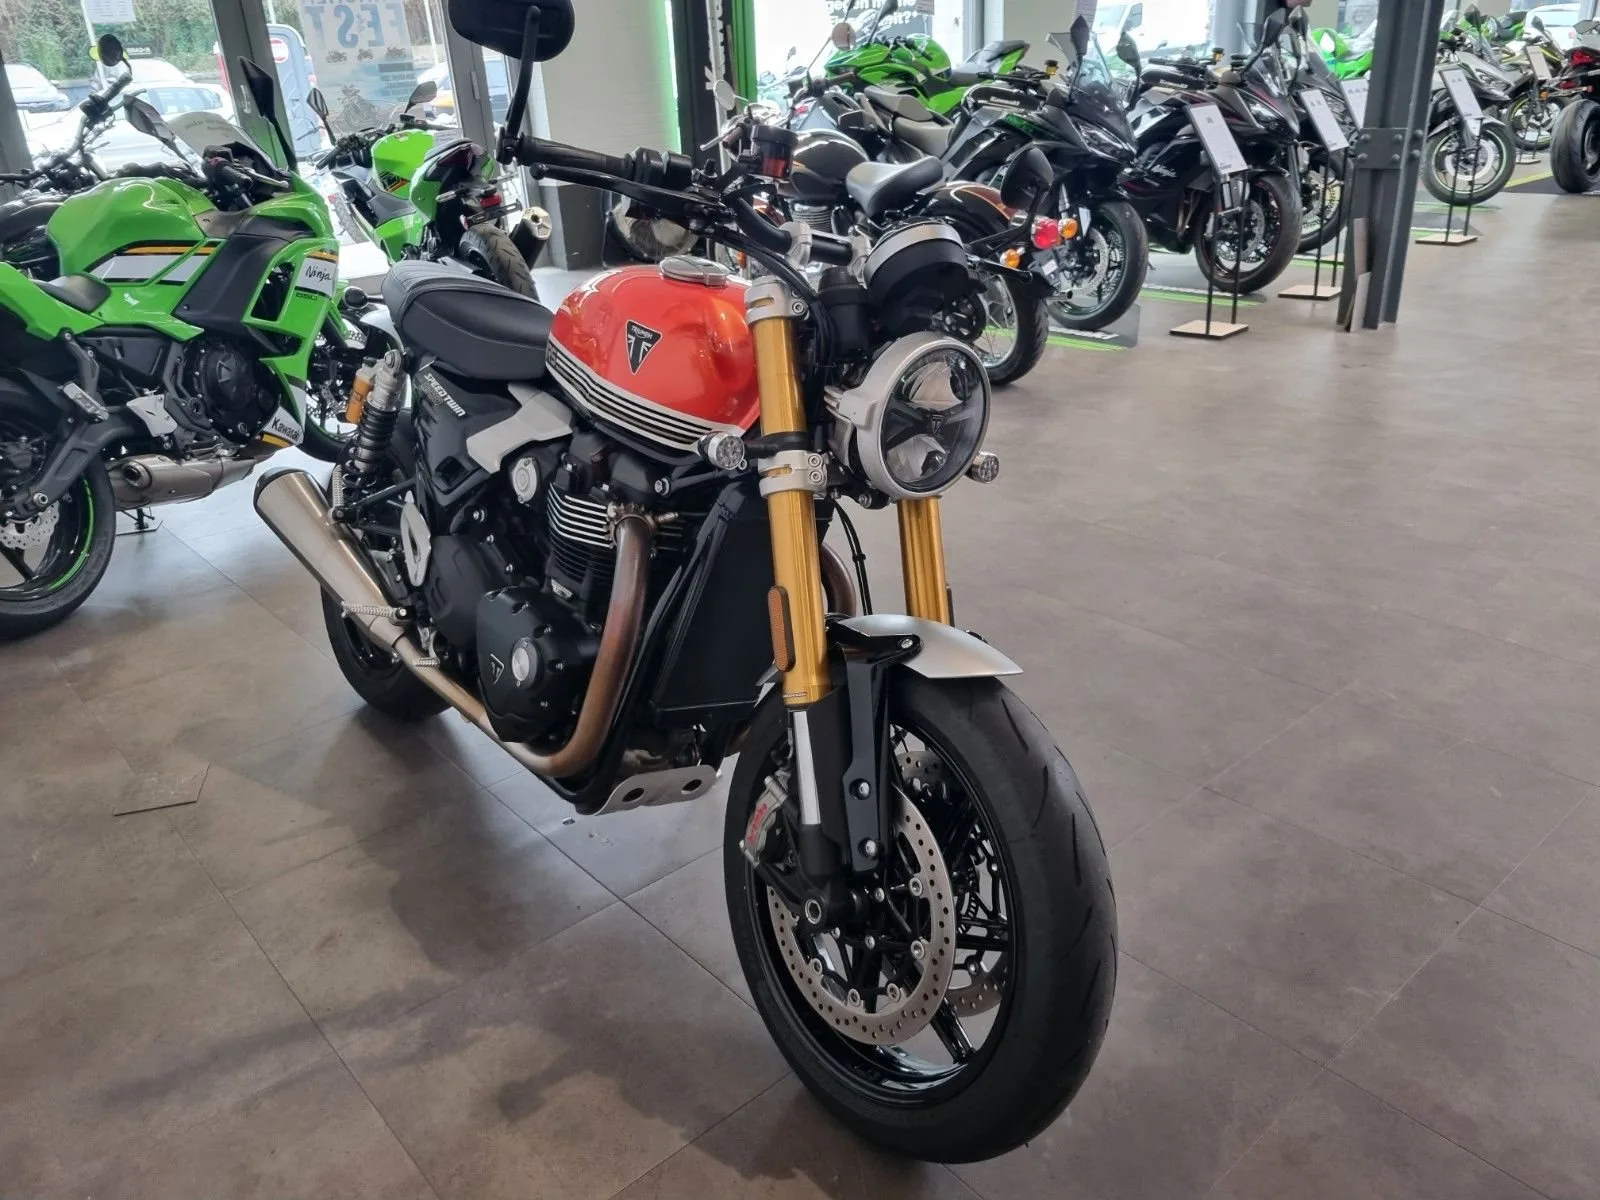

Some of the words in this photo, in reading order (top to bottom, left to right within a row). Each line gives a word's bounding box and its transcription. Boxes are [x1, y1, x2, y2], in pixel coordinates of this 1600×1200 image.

[305, 265, 332, 282] Ninja
[296, 292, 318, 300] 650
[631, 325, 653, 340] TRIUMPH
[424, 373, 447, 397] SPEED
[444, 395, 466, 417] TWIN
[271, 416, 302, 442] Kawasak
